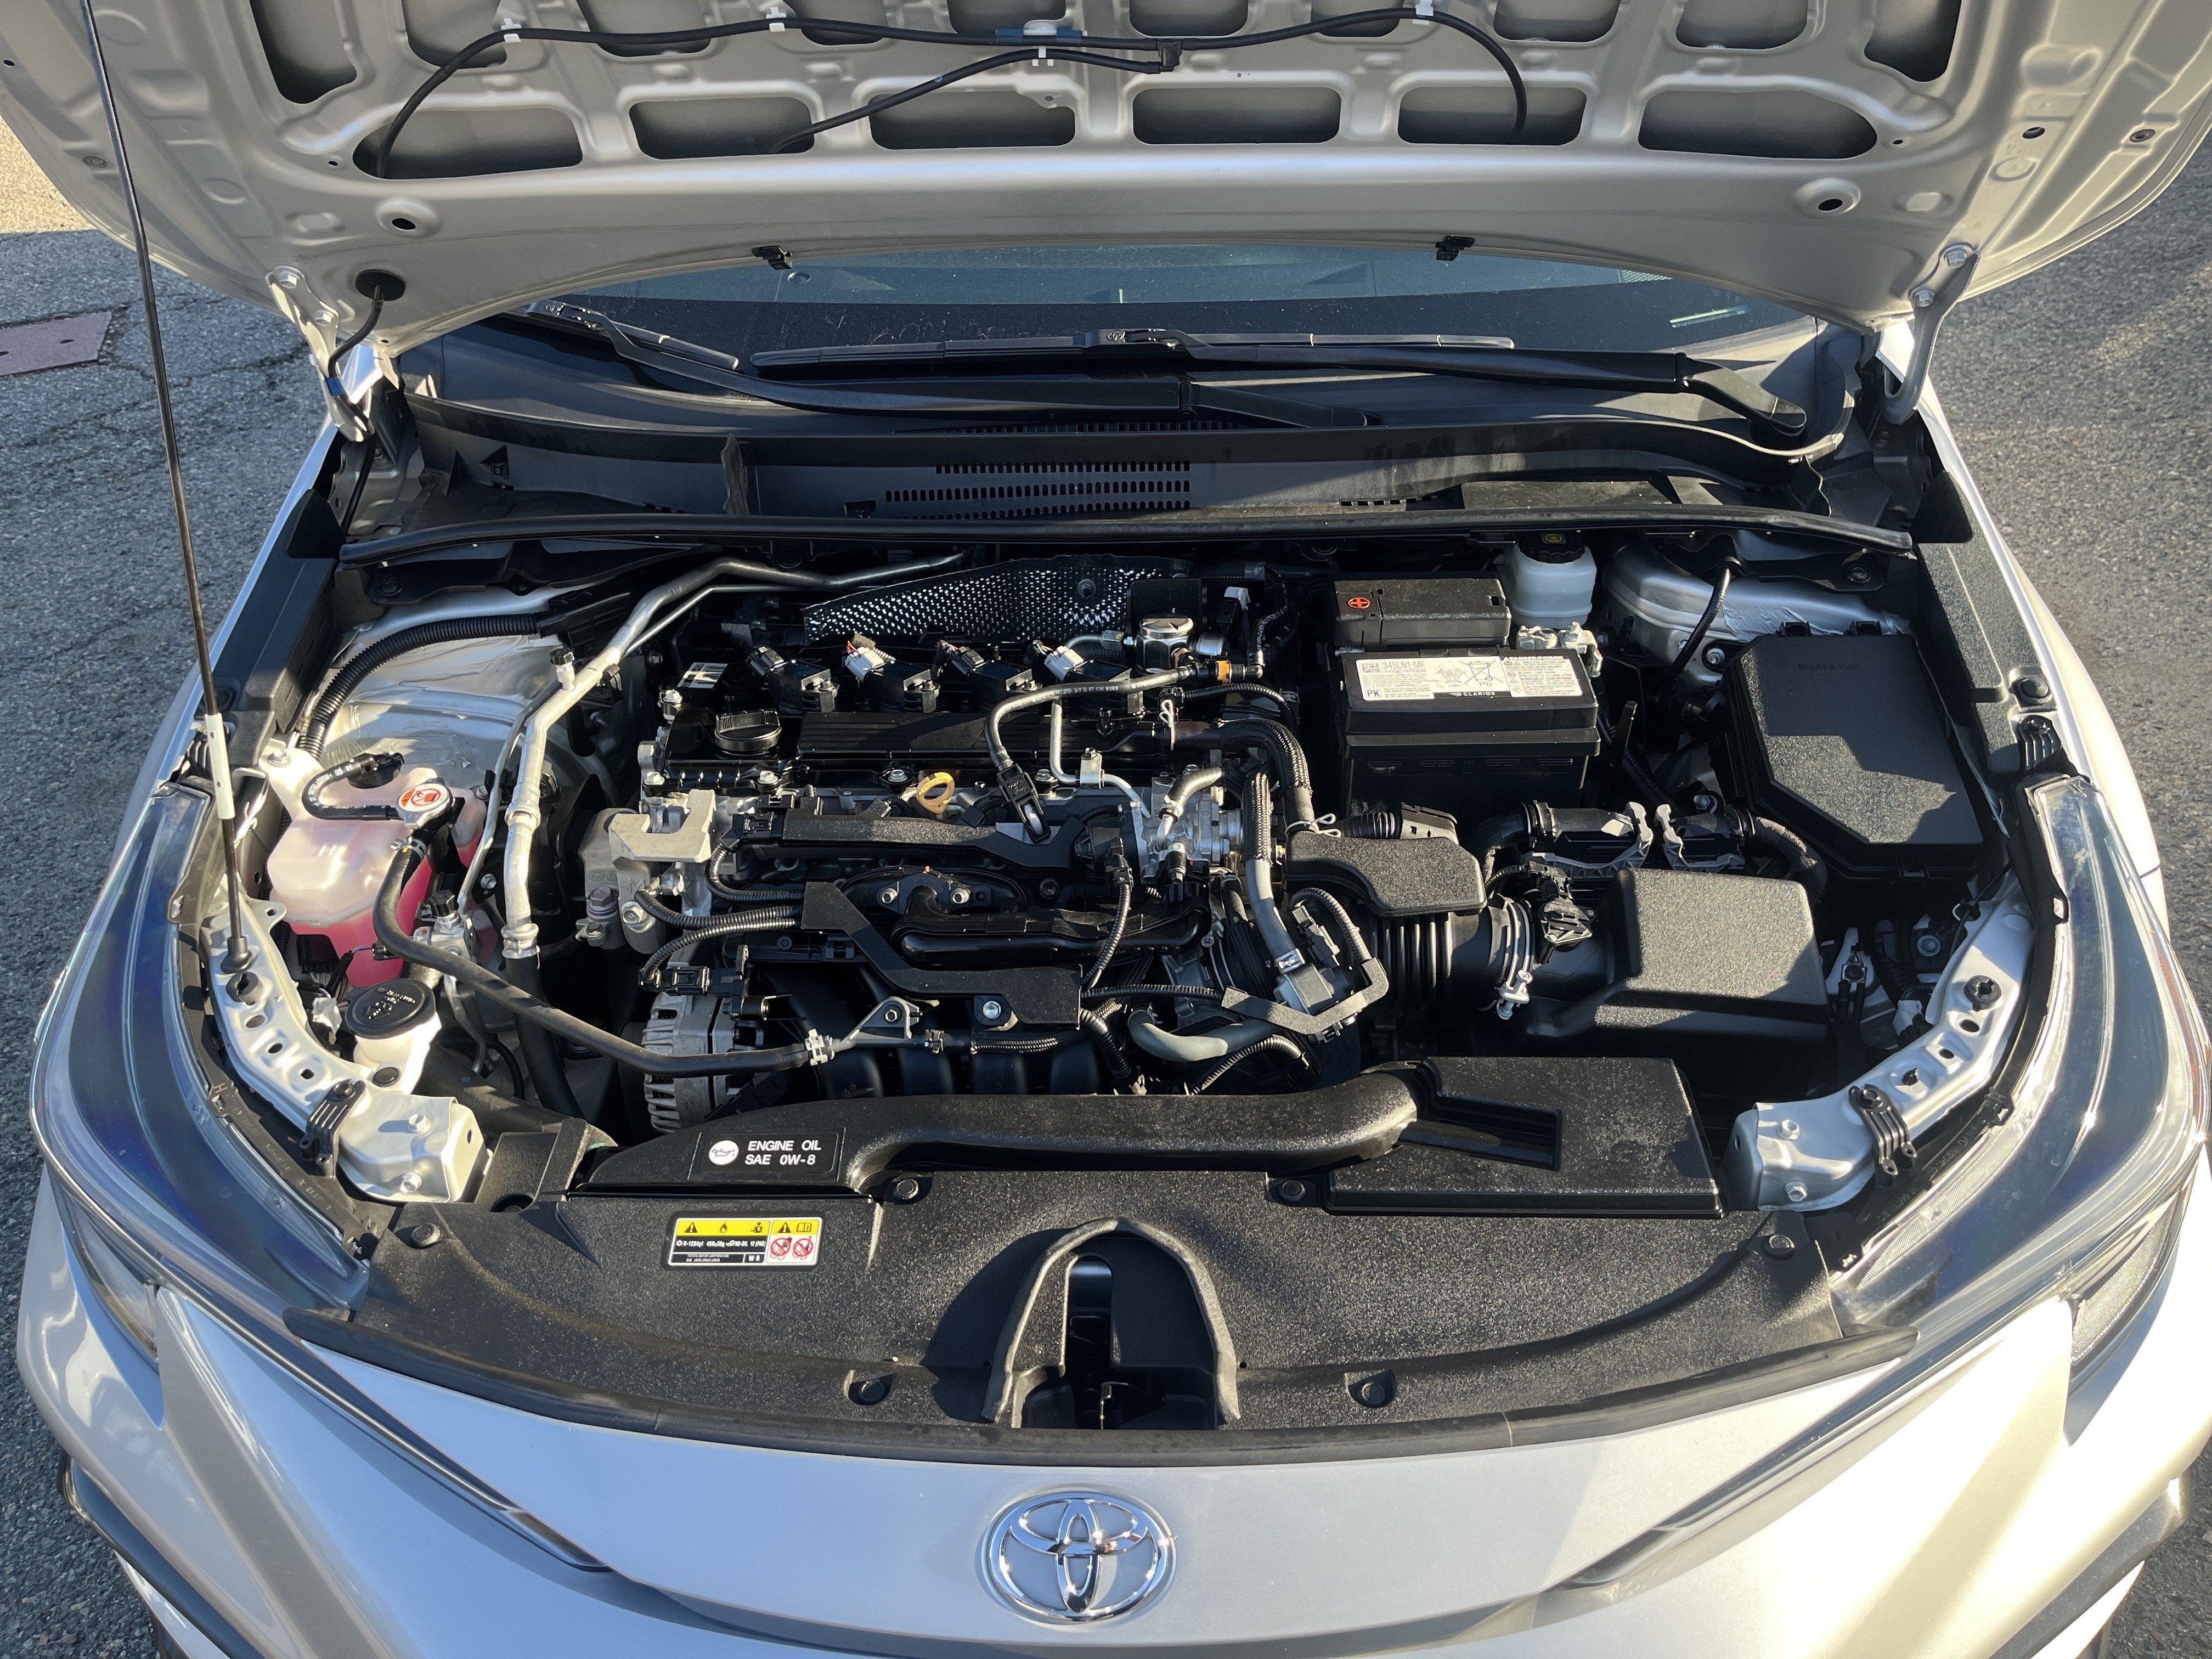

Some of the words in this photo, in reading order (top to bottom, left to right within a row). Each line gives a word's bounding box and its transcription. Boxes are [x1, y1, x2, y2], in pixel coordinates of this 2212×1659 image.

[1382, 660, 1425, 669] 345LN1-MF
[747, 1140, 794, 1151] ENGINE
[801, 1139, 822, 1151] OIL
[744, 1154, 772, 1165] SAE
[779, 1154, 816, 1165] 0W-8
